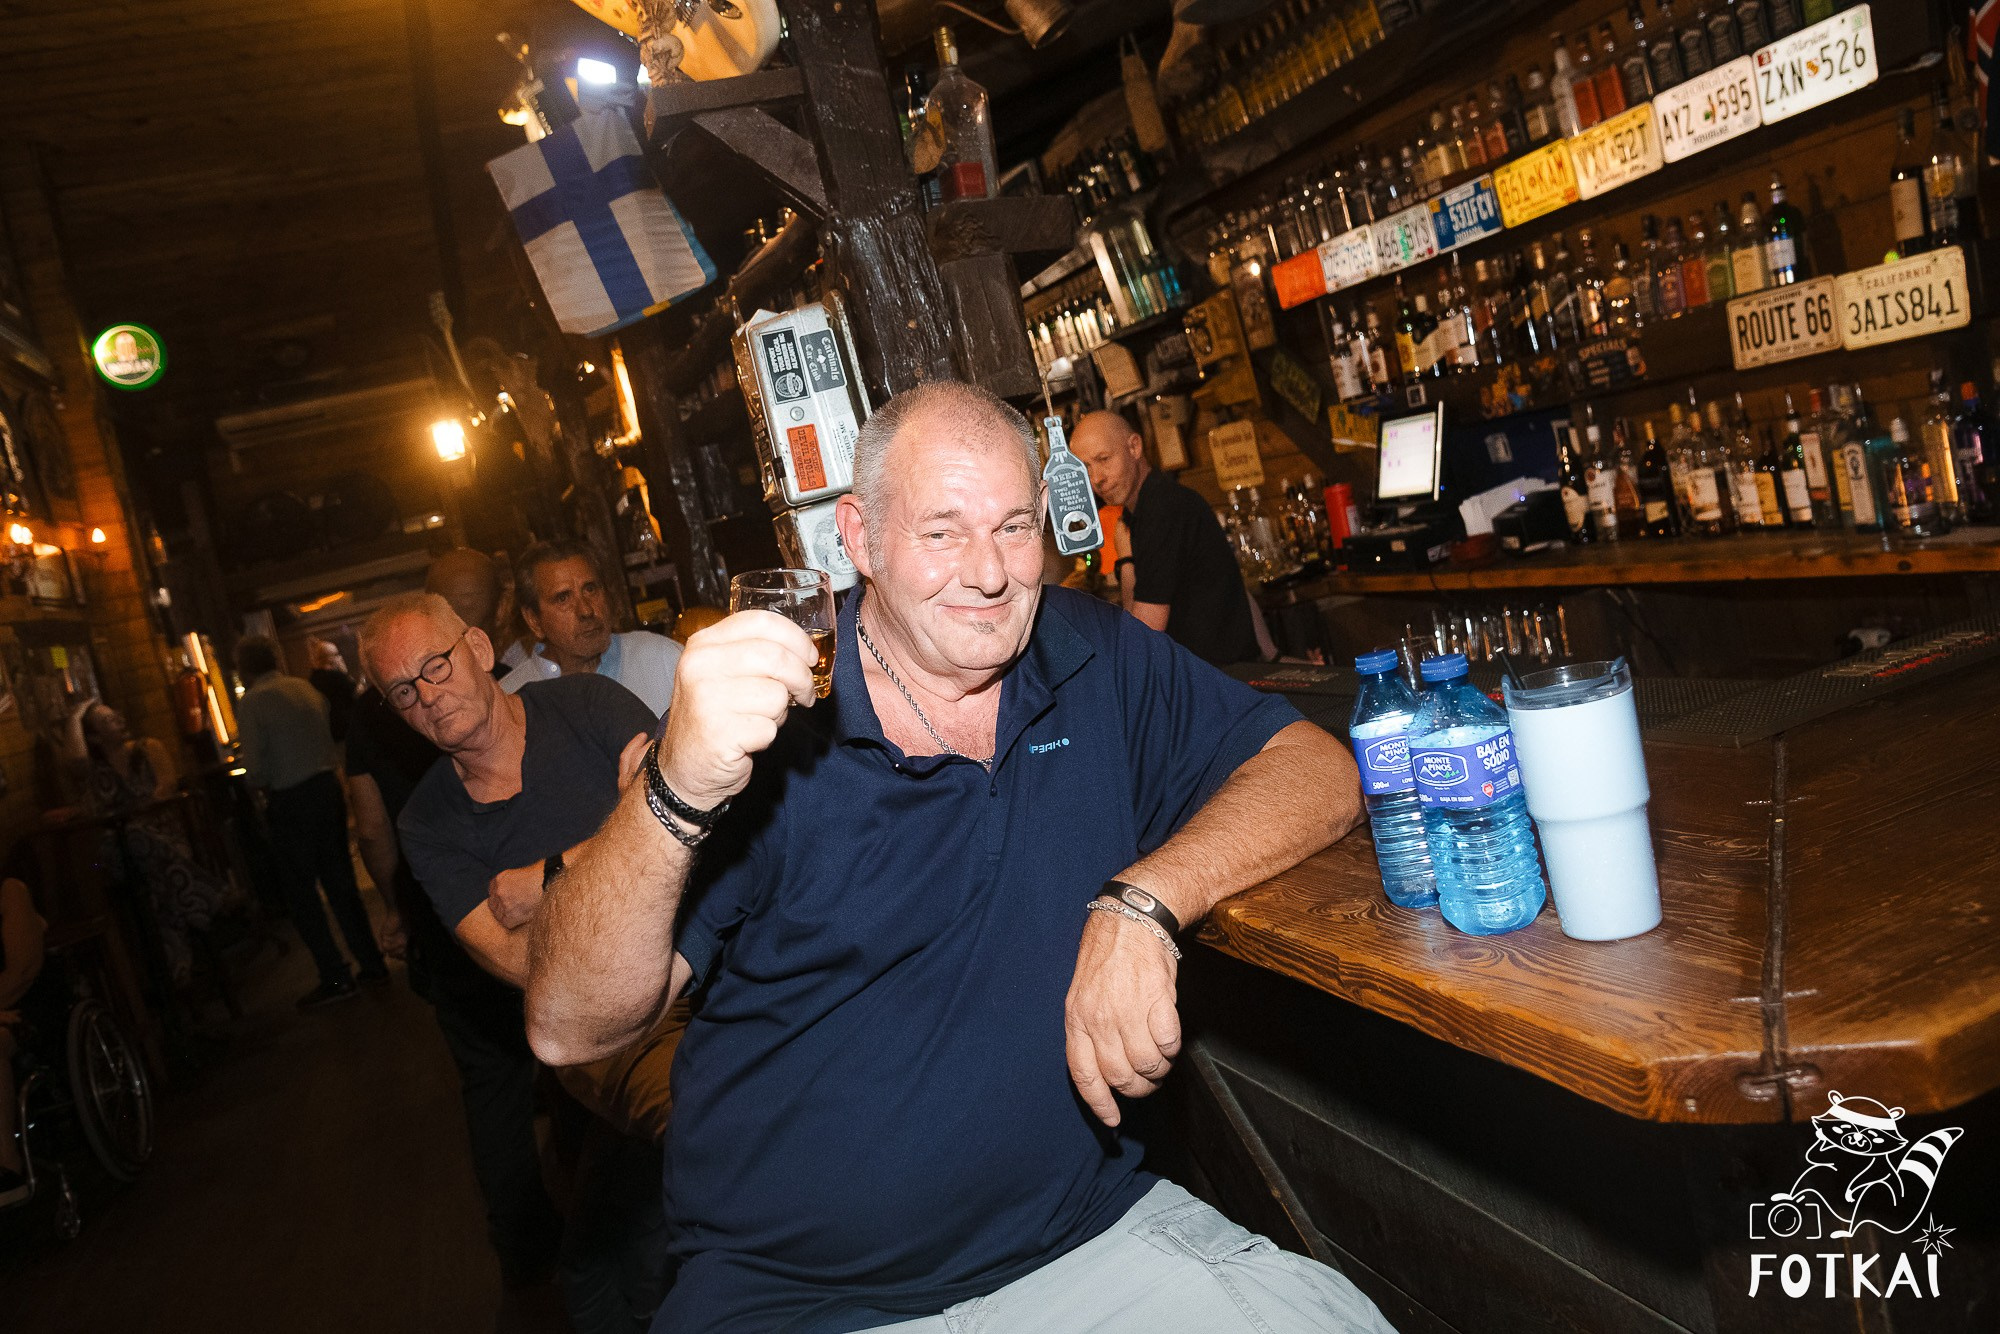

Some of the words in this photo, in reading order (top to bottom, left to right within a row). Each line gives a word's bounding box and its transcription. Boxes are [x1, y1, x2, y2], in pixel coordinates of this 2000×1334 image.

[1761, 57, 1805, 105] ZXN
[1820, 33, 1866, 81] 526
[1663, 104, 1694, 143] AYZ
[1865, 265, 1932, 290] CALIFORNIA
[1849, 279, 1960, 335] 3AIS841
[1736, 302, 1799, 352] ROUTE
[1805, 293, 1832, 336] 66
[805, 344, 813, 360] Car
[822, 336, 840, 381] Cardinals
[798, 429, 809, 456] DEVIL
[804, 458, 817, 487] DOLLS
[1052, 471, 1078, 482] BEER
[1379, 740, 1409, 751] MONT
[1476, 742, 1500, 759] BAJA
[1499, 733, 1511, 749] EN
[1423, 756, 1451, 765] MONTE
[1428, 763, 1453, 772] PINOS
[1483, 748, 1510, 770] SODIO
